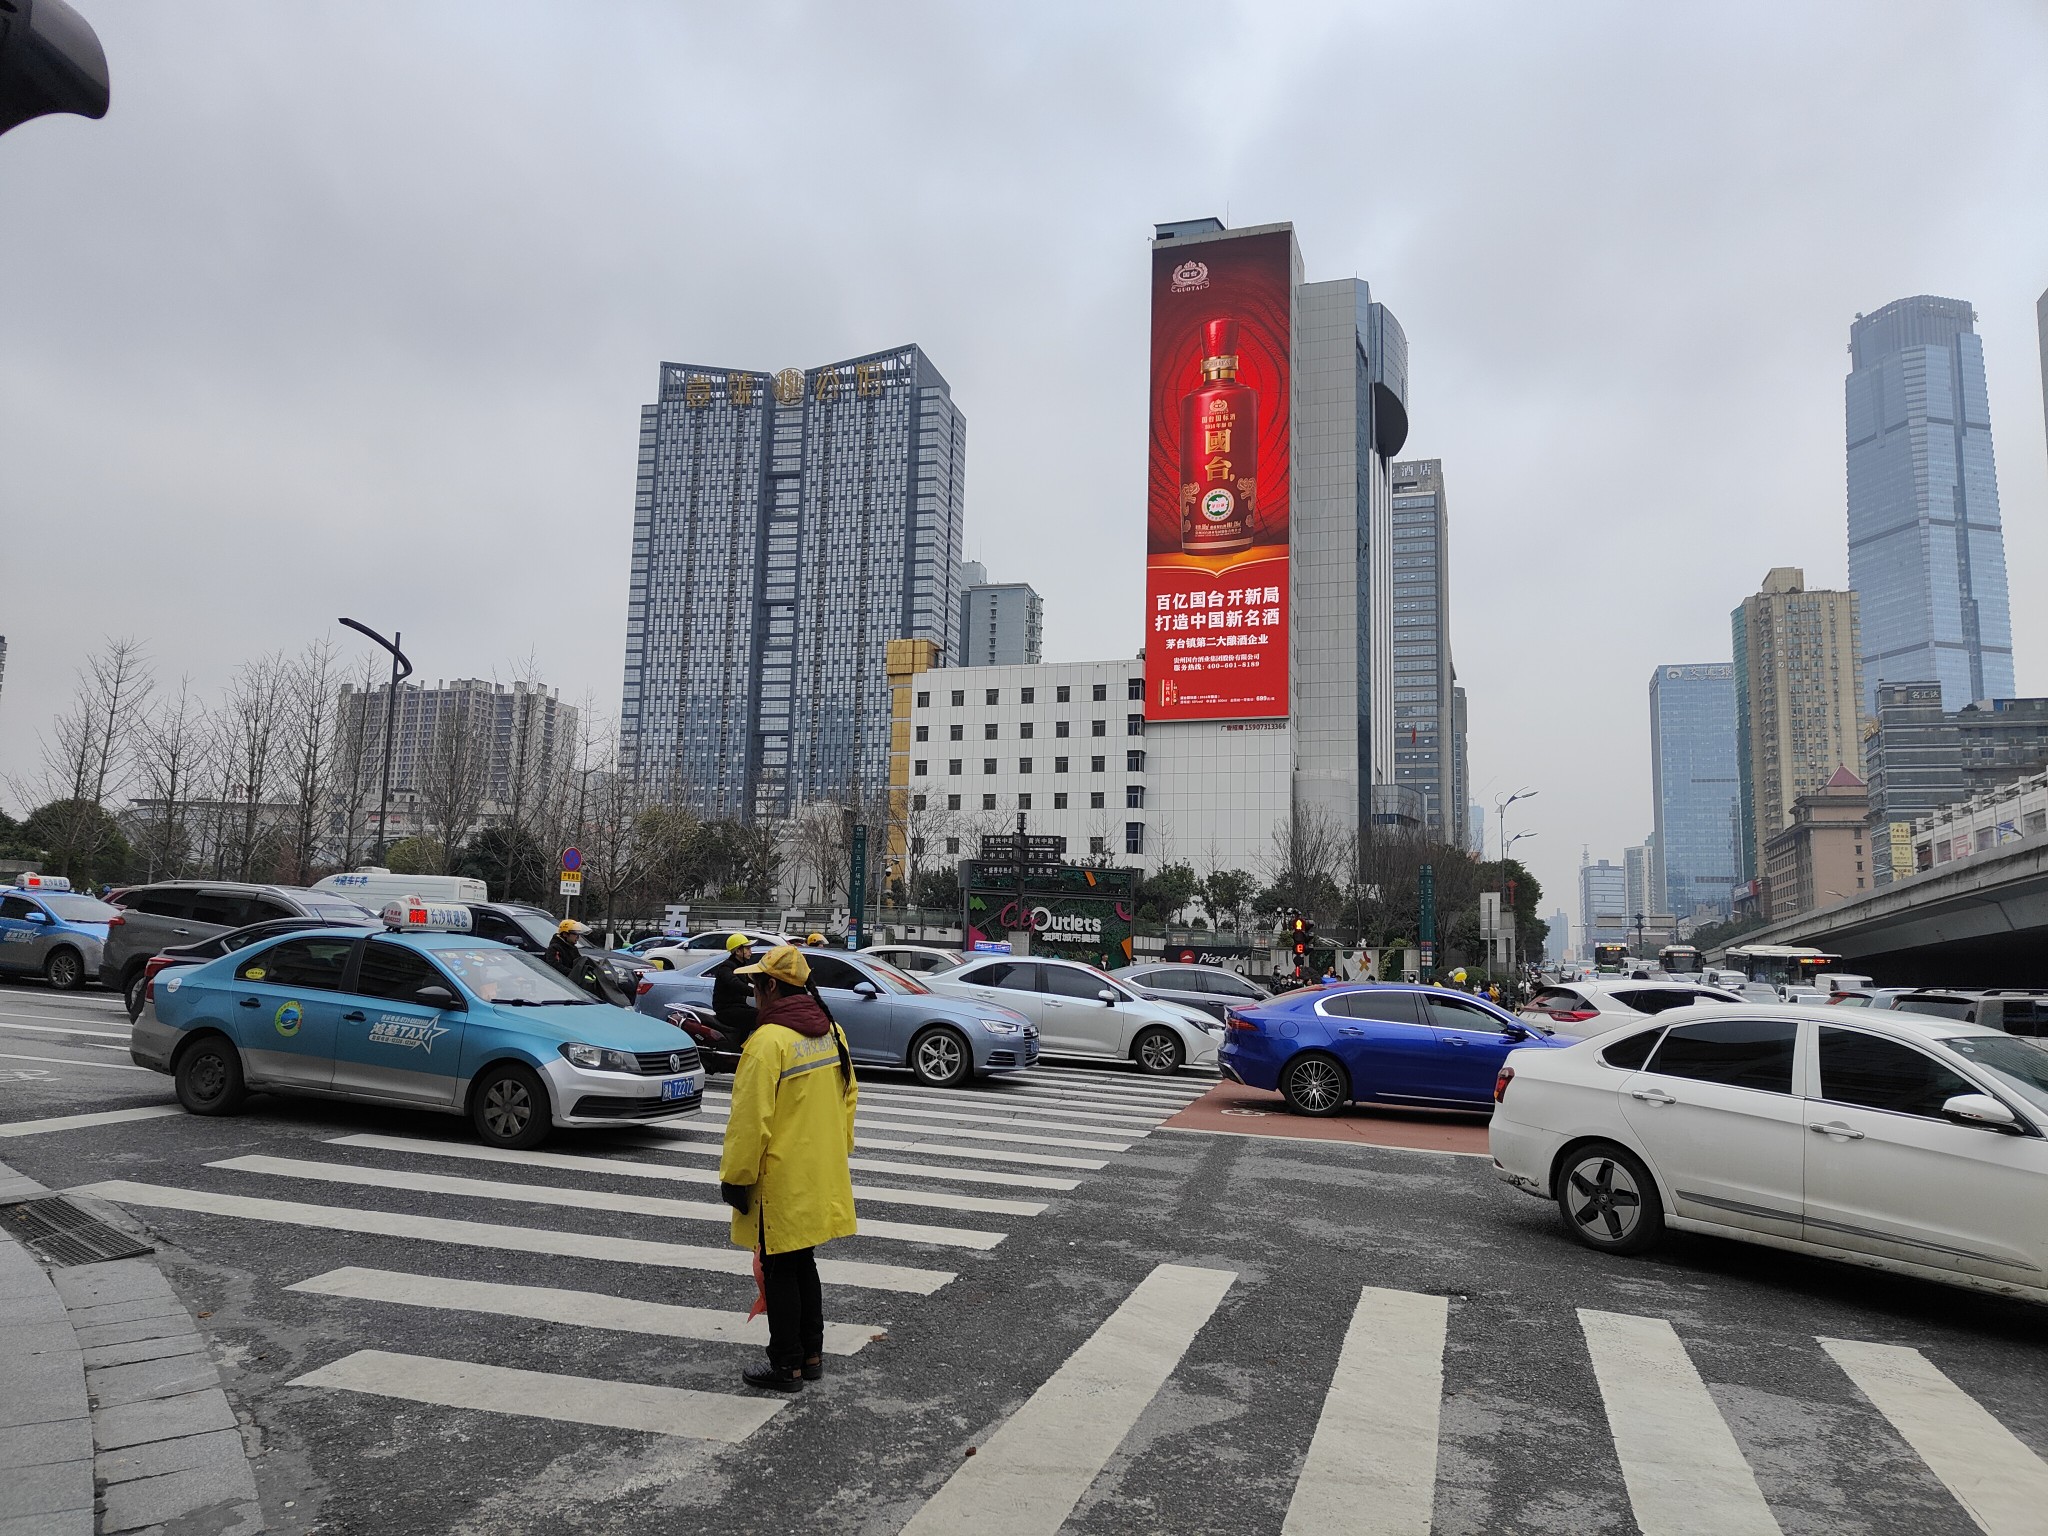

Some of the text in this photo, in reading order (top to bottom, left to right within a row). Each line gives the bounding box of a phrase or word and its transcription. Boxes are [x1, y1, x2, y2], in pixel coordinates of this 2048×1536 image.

[1177, 285, 1203, 293] GUOTAI
[1156, 586, 1280, 611] 百亿国台开新局
[1154, 608, 1280, 632] 打造中国新名酒
[1165, 633, 1269, 650] 茅台镇第二大酿酒企业
[1173, 653, 1260, 664] 贵州国台酒业集团股份有限公司
[1028, 837, 1054, 845] 黄兴中路
[430, 908, 468, 928] 长沙欢迎您
[1031, 906, 1102, 933] Outlets
[1198, 952, 1227, 964] Pizza
